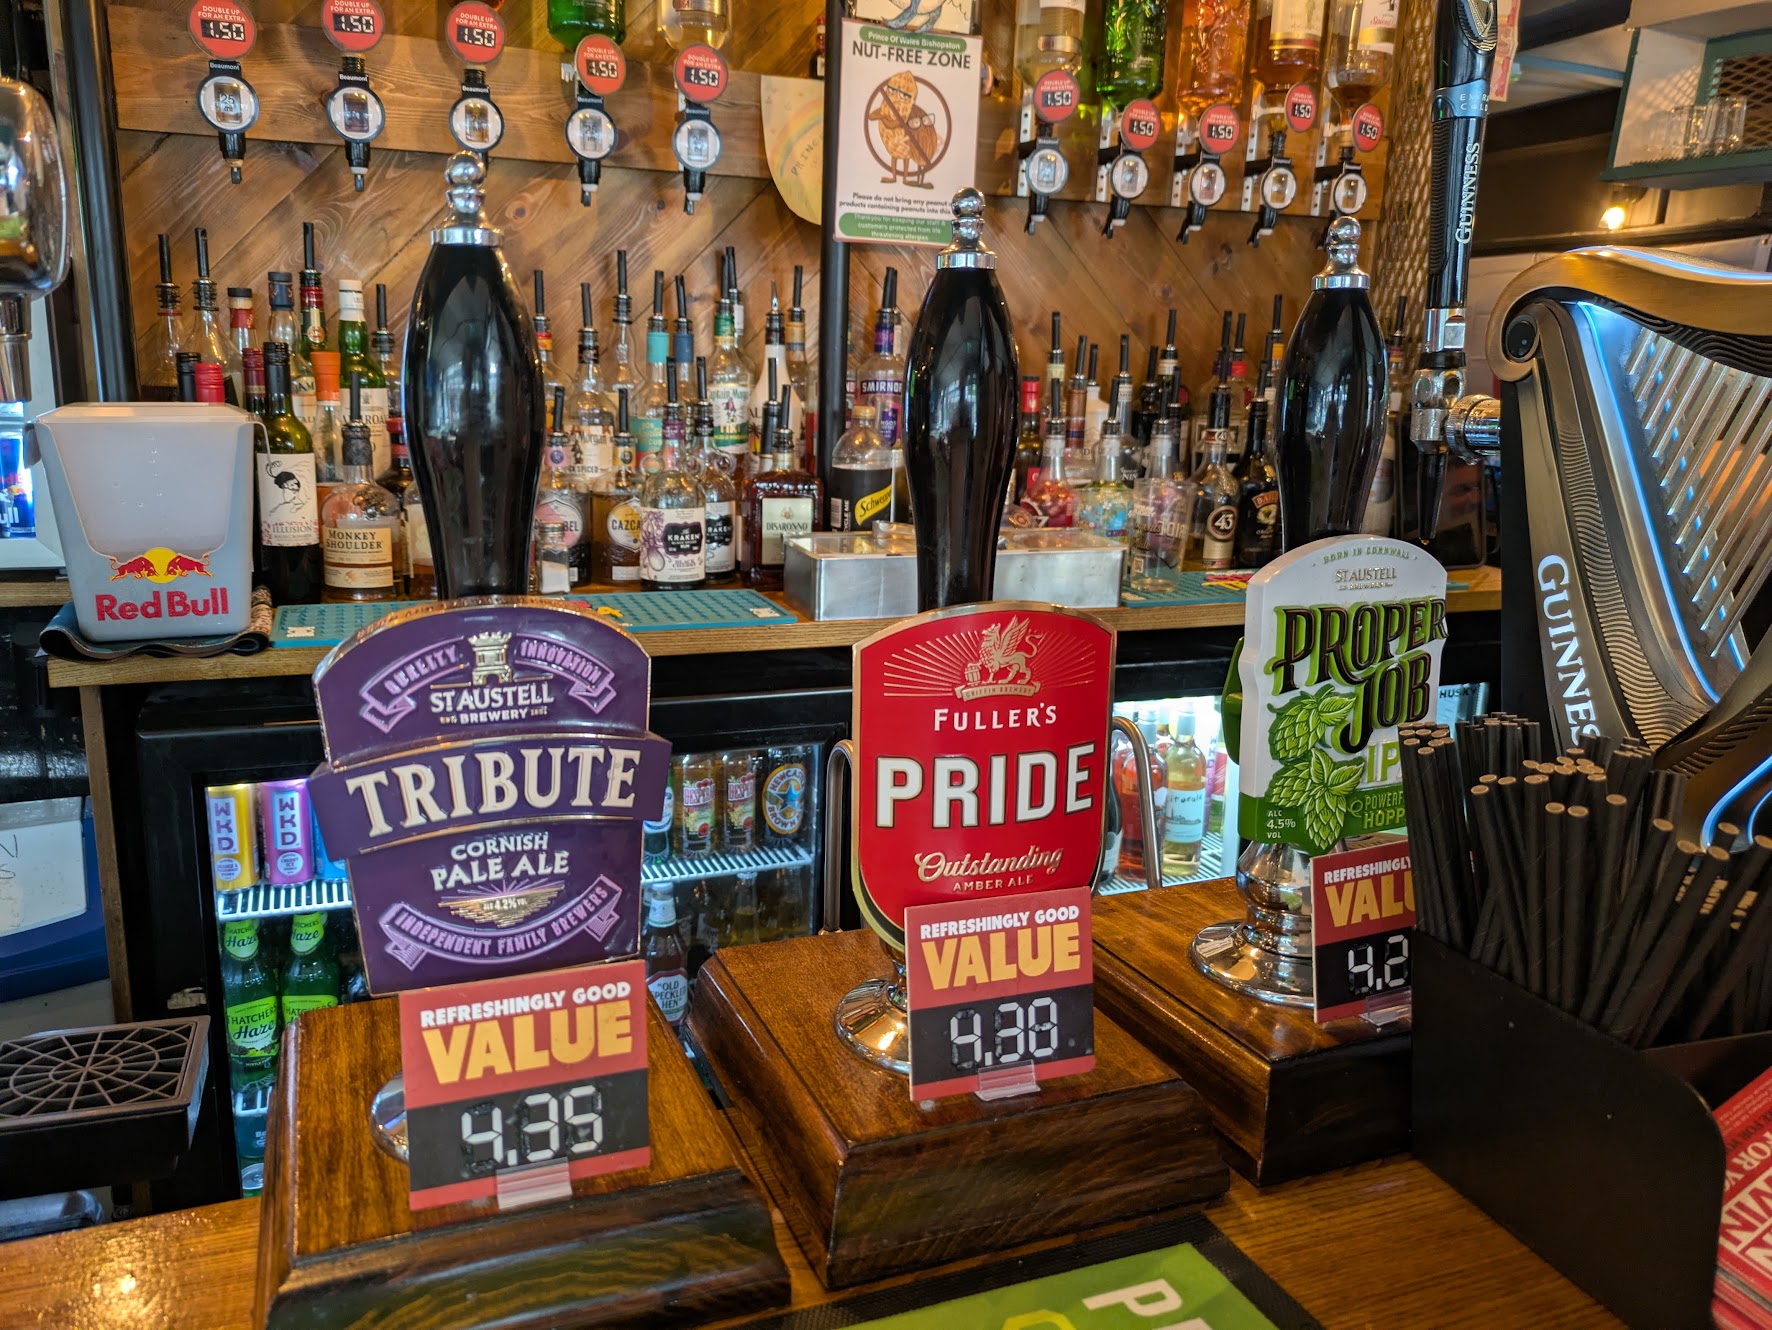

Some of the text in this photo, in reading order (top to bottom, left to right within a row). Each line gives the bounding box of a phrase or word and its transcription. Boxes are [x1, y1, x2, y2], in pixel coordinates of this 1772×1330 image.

[202, 6, 230, 15] DOUBLE
[460, 13, 485, 21] DOUBLE
[210, 22, 245, 41] 1.50
[341, 16, 374, 33] 1.50
[479, 22, 497, 30] EXTRA
[464, 28, 495, 47] 1.50
[868, 32, 960, 50] Prince Of Wales Bishopston
[853, 40, 971, 69] NUT-FREE ZONE
[210, 62, 240, 70] Beaumont
[591, 61, 618, 78] 1.50
[340, 74, 368, 82] Beaumont
[690, 69, 718, 86] 1.50
[1047, 92, 1072, 106] 1.50
[1132, 121, 1154, 136] 1.50
[1212, 126, 1233, 139] 1.50
[853, 192, 872, 200] Please
[895, 196, 911, 204] bring
[1455, 142, 1480, 244] GUINNESS
[867, 203, 899, 212] containing
[889, 225, 917, 233] protected
[709, 388, 749, 400] aptain Morg
[859, 490, 891, 517] Schwepp
[1256, 492, 1279, 505] BAIL
[272, 525, 312, 533] ILLUSION
[612, 519, 641, 531] CAZCA
[766, 522, 808, 531] DISARONNO
[1214, 513, 1233, 530] 43
[326, 540, 382, 549] SHOULDER
[328, 530, 376, 540] MONKEY
[1323, 546, 1410, 564] BORN IN CORNWALL
[1335, 566, 1397, 582] ST AUSTELL
[95, 587, 229, 622] Red Bull
[1265, 596, 1448, 696] PROPER
[384, 640, 602, 695] QUALITY INNOVATION
[430, 683, 554, 713] ST AUSTELL
[966, 686, 1032, 698] GRIFFIN BREWERY
[1439, 687, 1476, 698] HUSKY
[1332, 650, 1432, 754] JOB
[460, 708, 528, 724] BREWERY
[934, 703, 1057, 732] FULLER'S
[1366, 740, 1402, 783] IP
[769, 769, 806, 791] NEWCAS
[876, 740, 1096, 828] PRIDE
[346, 747, 642, 838] TRIBUTE
[684, 784, 715, 806] DESPER
[729, 782, 754, 800] DESPE
[1365, 791, 1403, 810] POWERF
[214, 802, 234, 851] WKD
[279, 797, 297, 846] WKD
[768, 806, 796, 828] BROWN
[1267, 819, 1296, 829] 4.5%
[1364, 808, 1406, 830] HOPP
[451, 832, 548, 861] CORNISH
[431, 850, 569, 891] PALE ALE
[914, 845, 1064, 882] Outstanding
[953, 875, 1033, 892] AMBER ALE
[494, 898, 517, 911] 4.2%
[1325, 870, 1415, 928] VAL
[394, 886, 608, 956] INDEPENDENT FAMILY BREWERS
[920, 905, 1079, 940] REFRESHINGLY GOOD
[921, 922, 1081, 990] VALUE
[420, 981, 631, 1028] REFRESHINGLY GOOD
[227, 1005, 277, 1025] THATCHERS
[233, 1020, 275, 1039] Haze
[422, 1000, 633, 1086] VALUE
[461, 1084, 602, 1167] 4.35
